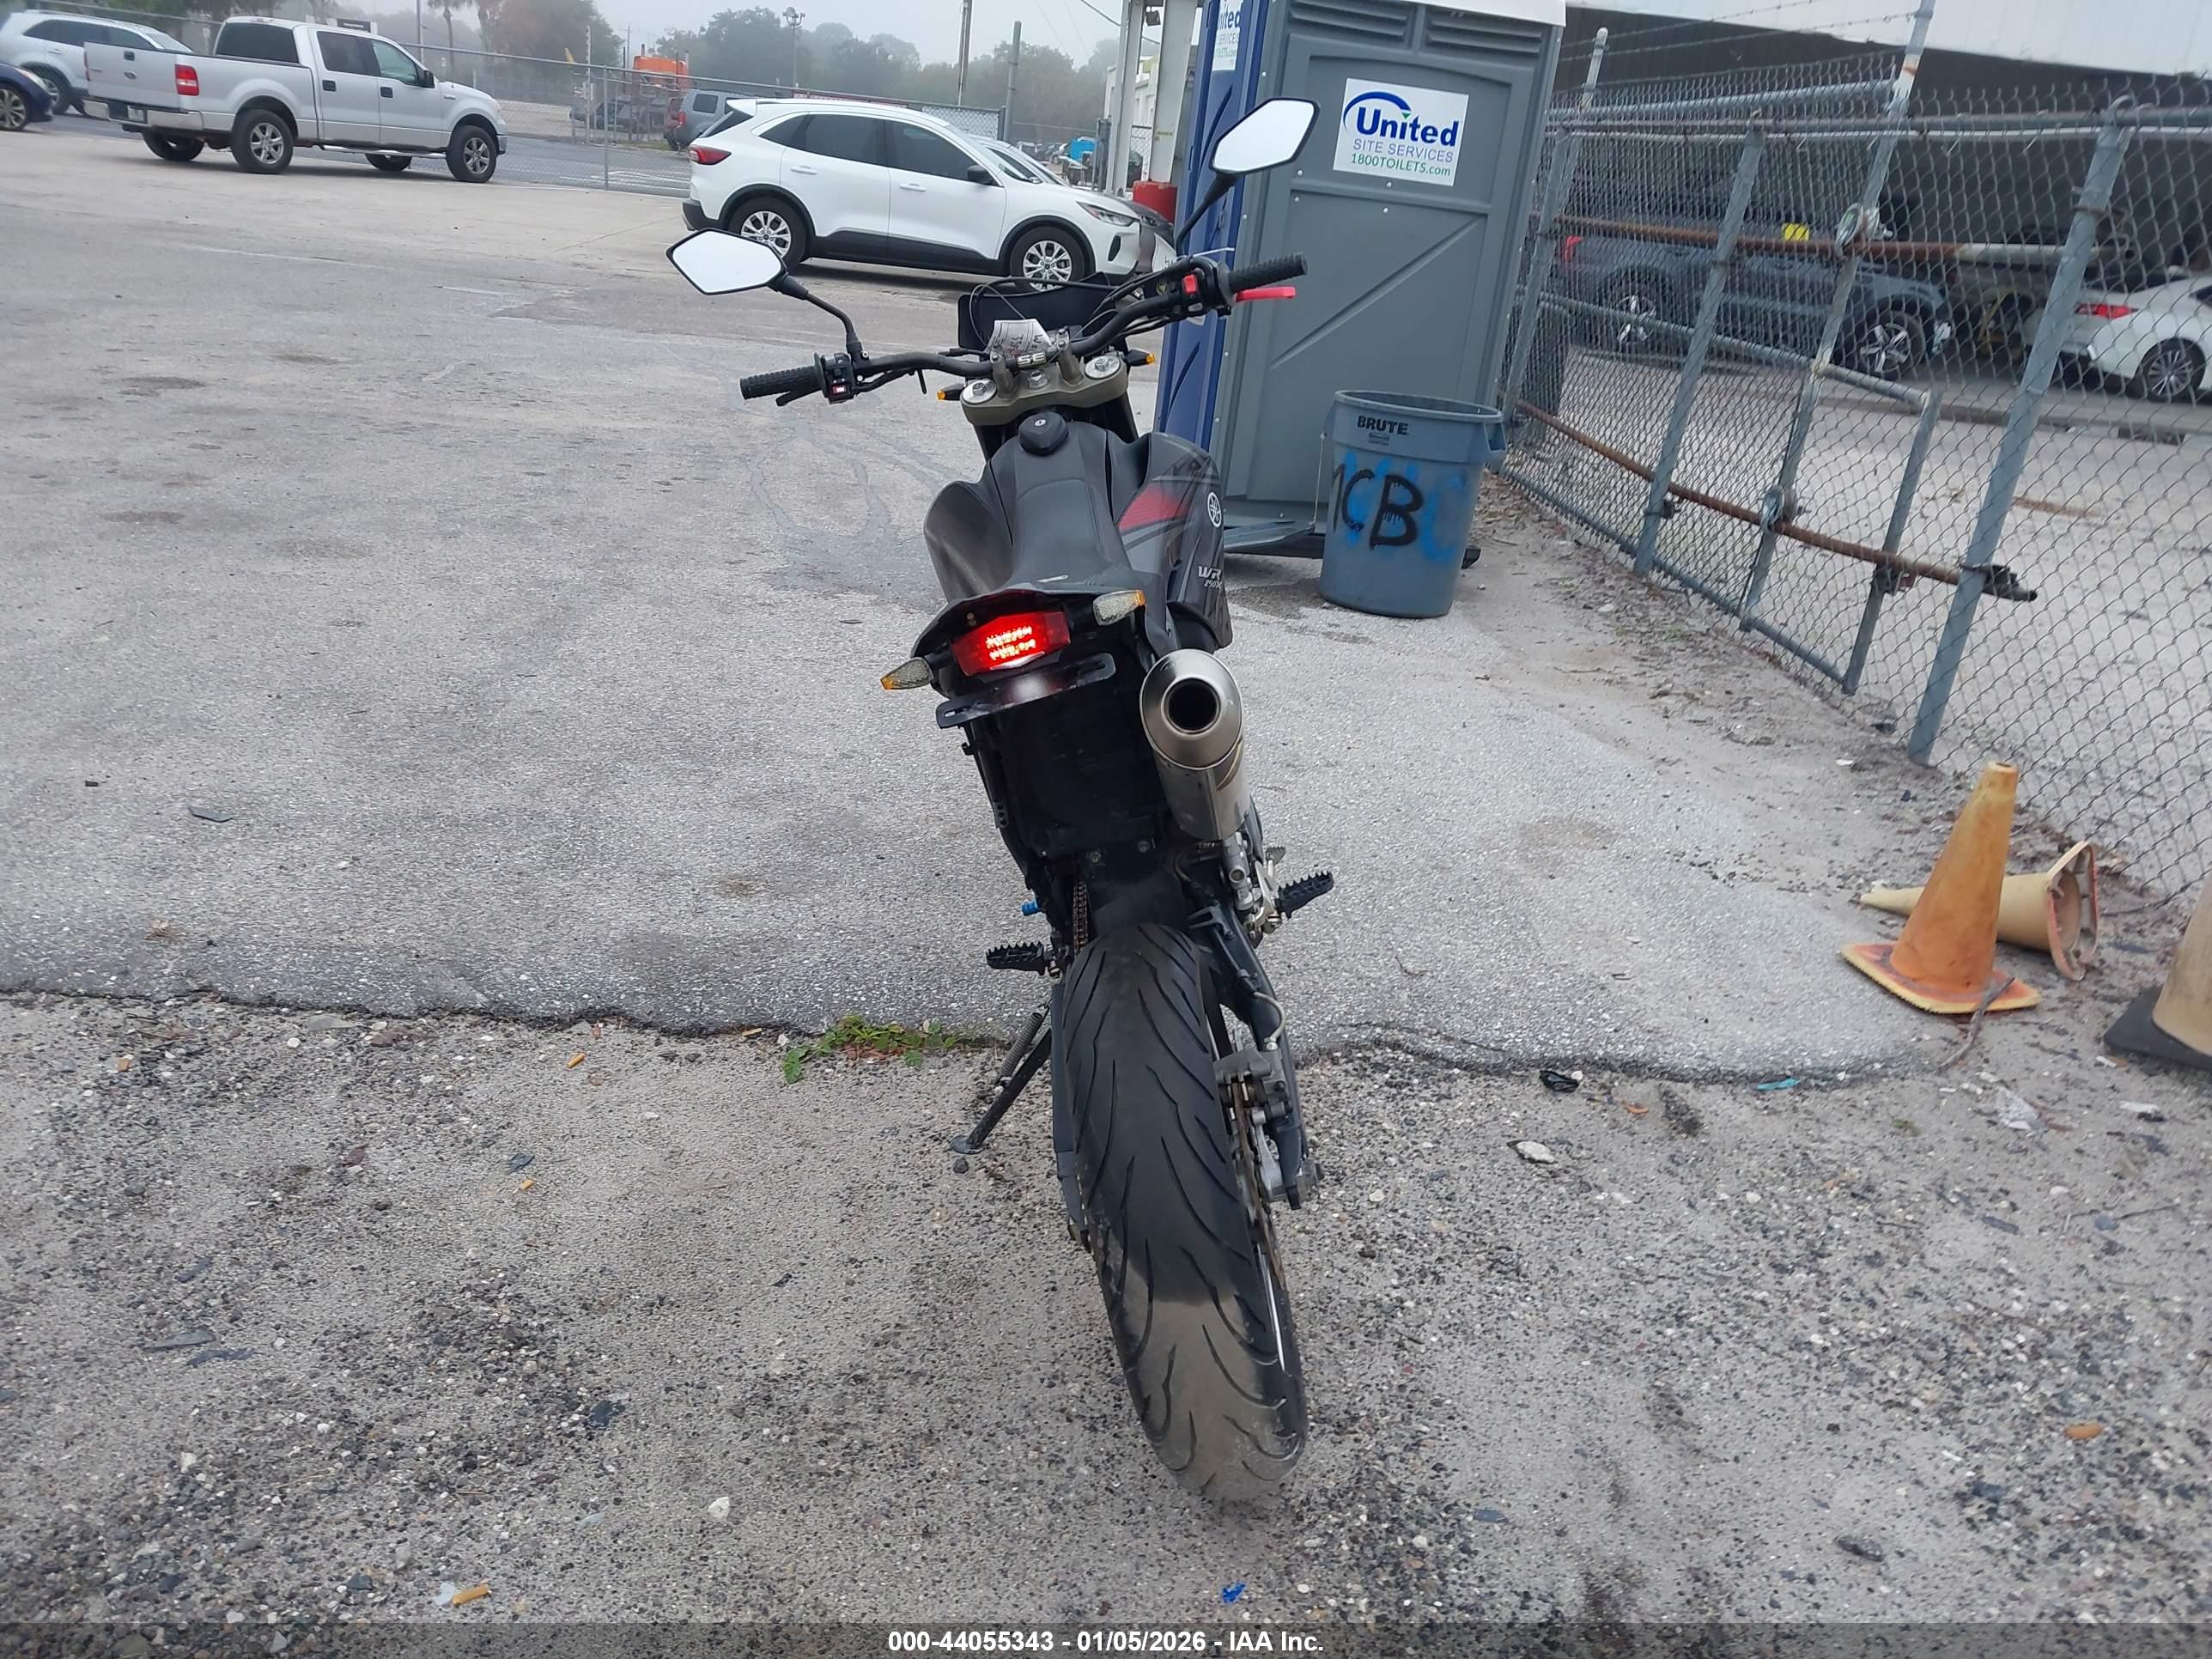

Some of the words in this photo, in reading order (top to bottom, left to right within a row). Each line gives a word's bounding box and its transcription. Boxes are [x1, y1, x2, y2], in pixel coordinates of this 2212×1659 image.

[1356, 106, 1460, 147] United
[1353, 138, 1383, 153] SITE
[1388, 143, 1454, 163] SERVICES
[1352, 153, 1451, 177] 1800TOILETS.com
[1357, 416, 1409, 435] BRUTE
[1198, 566, 1222, 580] WR
